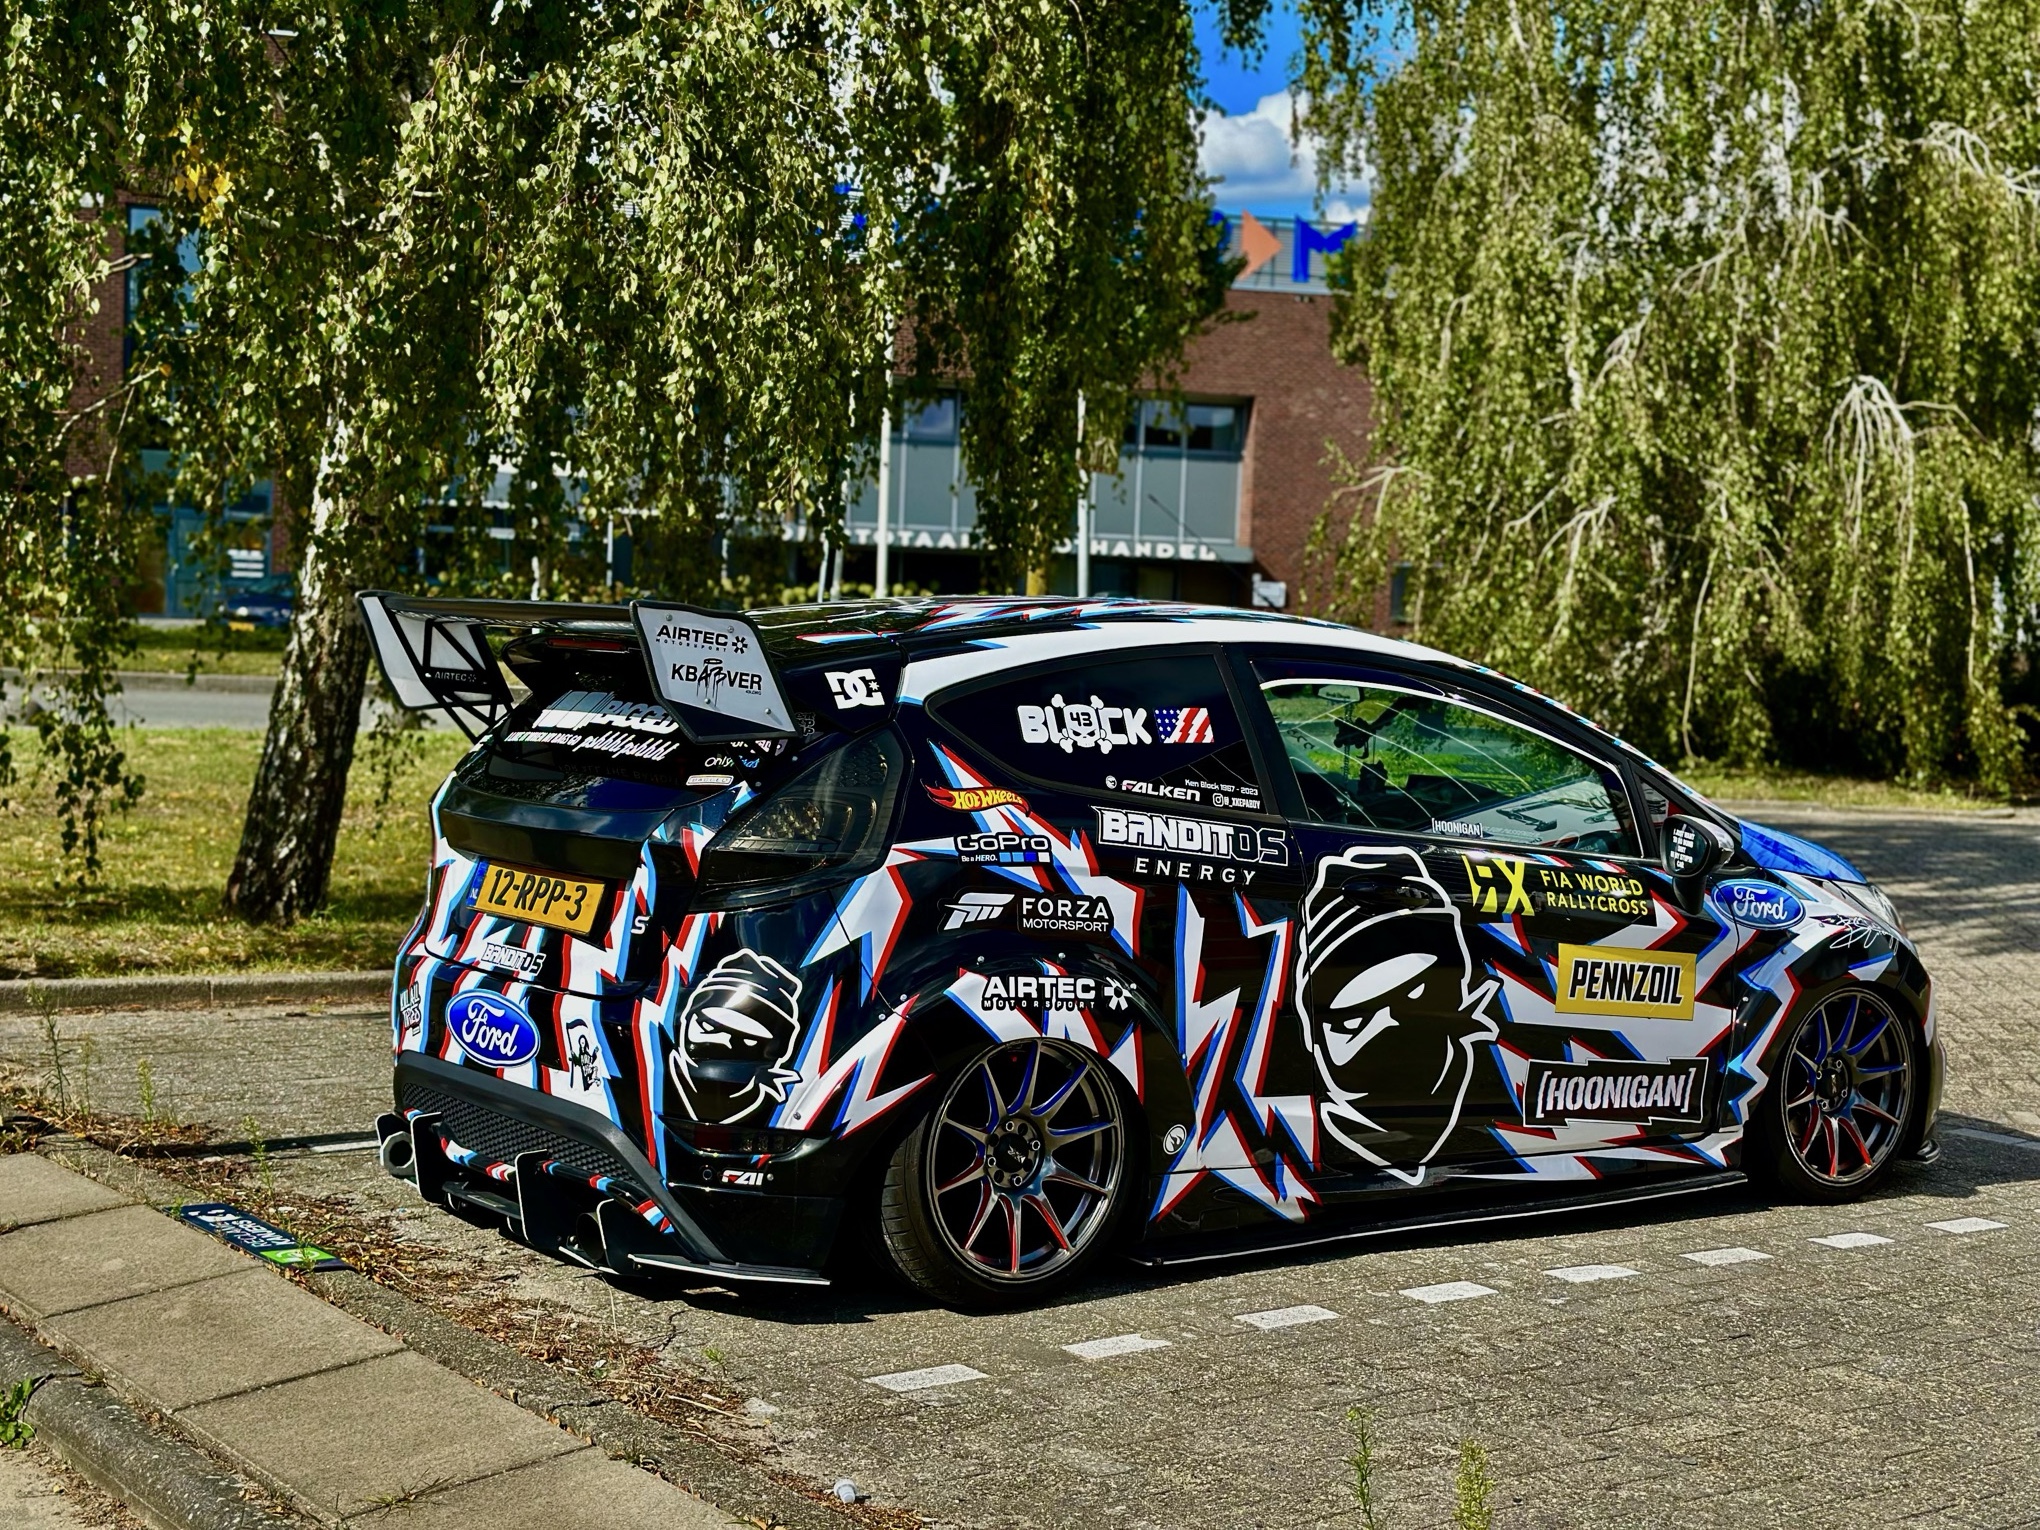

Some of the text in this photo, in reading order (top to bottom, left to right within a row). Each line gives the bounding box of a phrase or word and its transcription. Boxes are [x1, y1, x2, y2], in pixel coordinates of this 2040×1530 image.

[656, 638, 727, 652] MOTORSPORT
[657, 625, 728, 646] AIRTEC
[434, 671, 467, 681] AIRTEC
[824, 668, 885, 709] DC
[1070, 712, 1092, 727] 43
[1121, 780, 1200, 801] FALKEN
[1185, 779, 1199, 788] Ken
[1201, 781, 1220, 791] Block
[1241, 786, 1259, 796] 2023
[957, 834, 1049, 851] GoPro
[1097, 807, 1289, 867] BANDITOS
[1135, 857, 1256, 885] ENERGY
[1540, 870, 1644, 896] FIA WORLD
[488, 869, 588, 922] 12-RPP-3
[1547, 891, 1649, 916] RALLYCROSS
[1733, 885, 1788, 921] Ford
[1022, 898, 1109, 919] FORZA
[1022, 918, 1109, 933] MOTORSPORT
[481, 942, 546, 976] BANDITOS
[984, 976, 1096, 1000] AIRTEC
[1568, 959, 1684, 1005] PENNZOIL
[984, 1000, 1095, 1010] MOTORSPORT
[462, 998, 520, 1057] Ford
